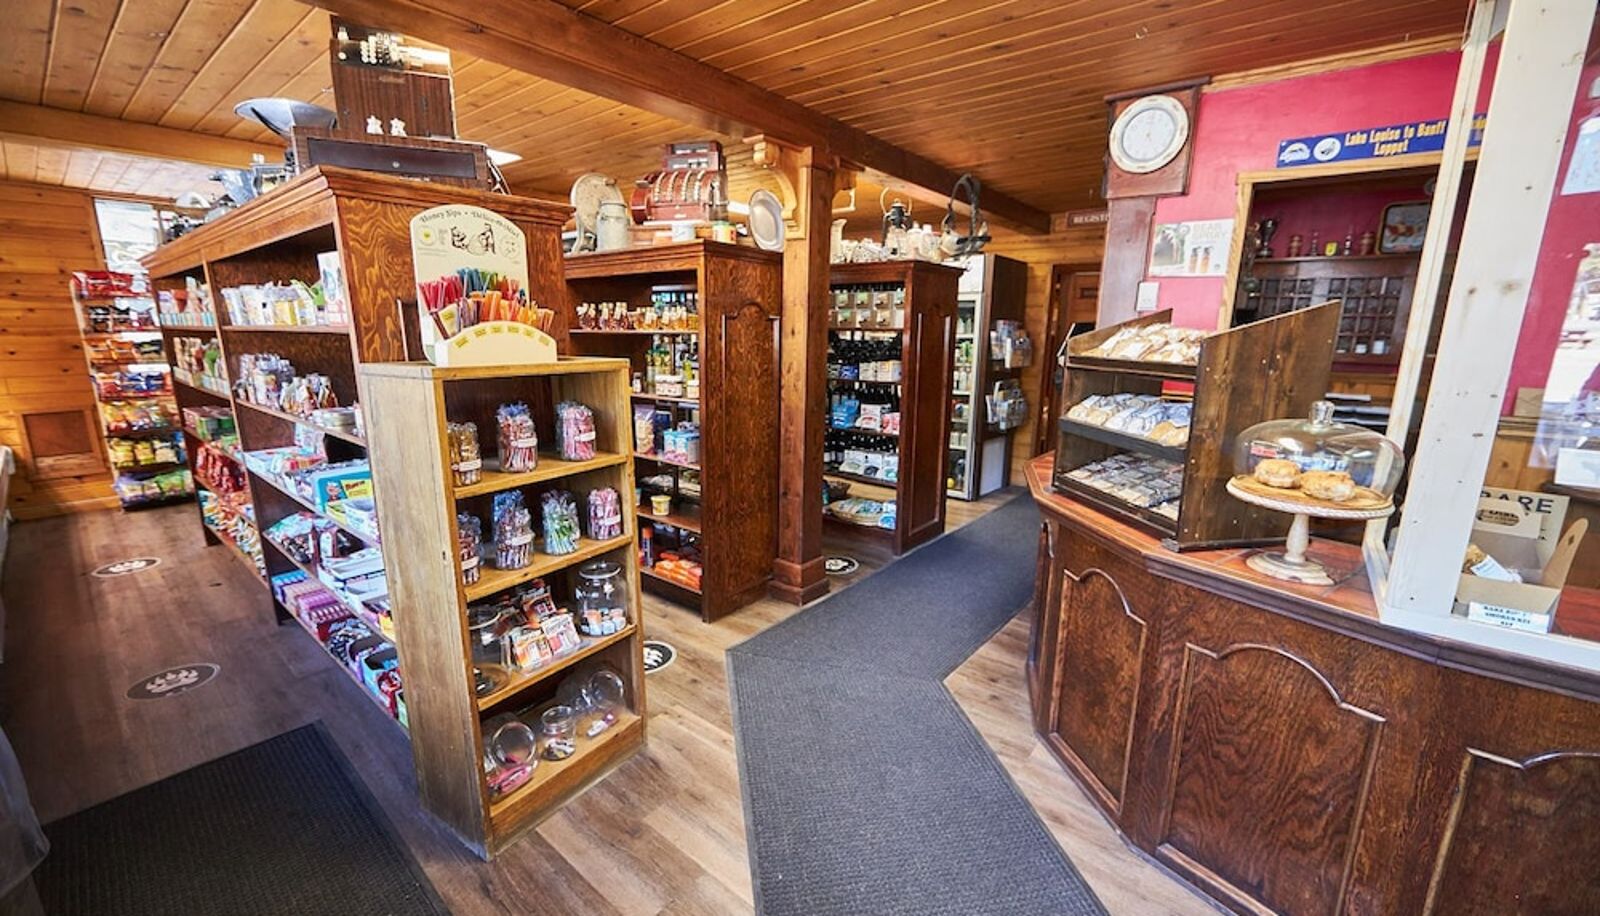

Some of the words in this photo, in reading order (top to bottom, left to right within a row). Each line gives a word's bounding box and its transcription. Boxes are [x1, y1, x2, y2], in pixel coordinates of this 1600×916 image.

[1345, 132, 1368, 147] Lake
[1370, 128, 1401, 143] Louise
[1404, 124, 1415, 138] to
[1417, 120, 1447, 137] Banff
[1374, 139, 1409, 157] Loppet
